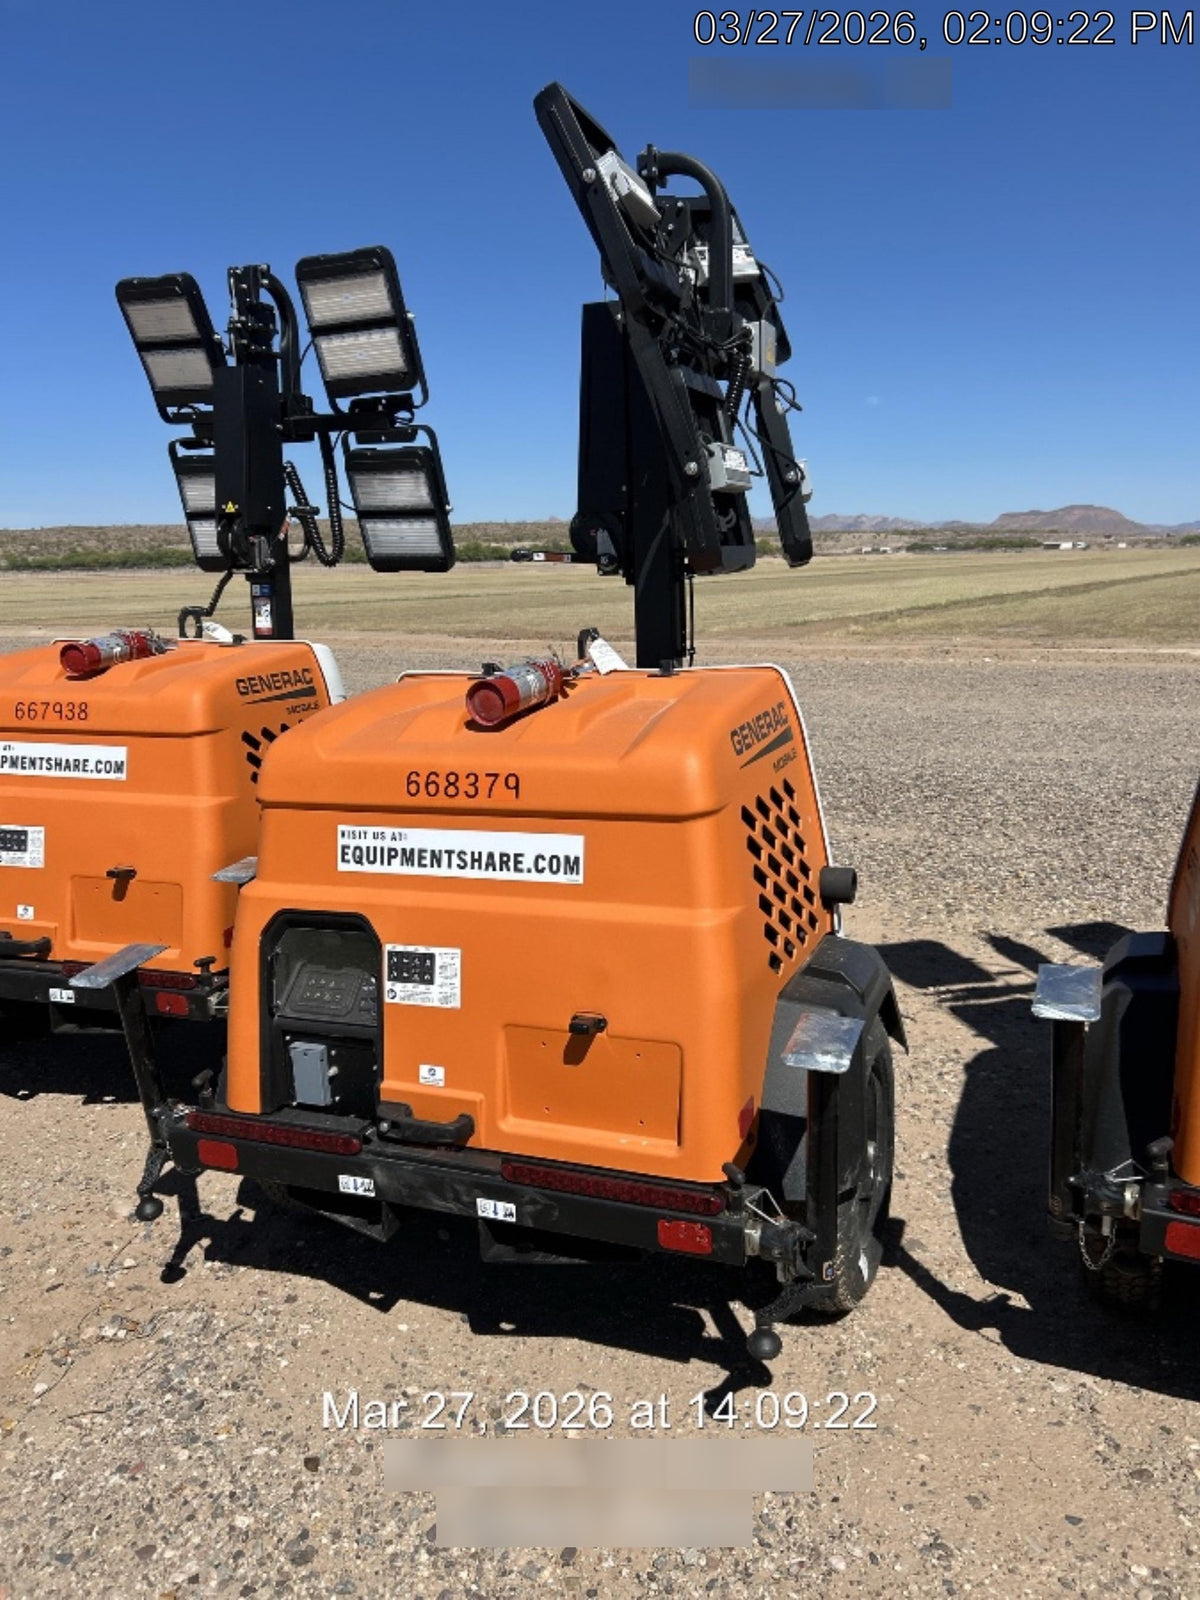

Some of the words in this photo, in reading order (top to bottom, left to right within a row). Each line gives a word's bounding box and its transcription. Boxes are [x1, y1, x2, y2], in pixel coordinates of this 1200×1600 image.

[236, 668, 313, 696] GENERAC
[15, 701, 89, 721] 667938
[730, 701, 788, 756] GENERAC
[405, 770, 520, 800] 668379
[340, 830, 368, 841] VISIT
[372, 831, 387, 842] US
[340, 844, 581, 877] EQUIPMENTSHARE.COM
